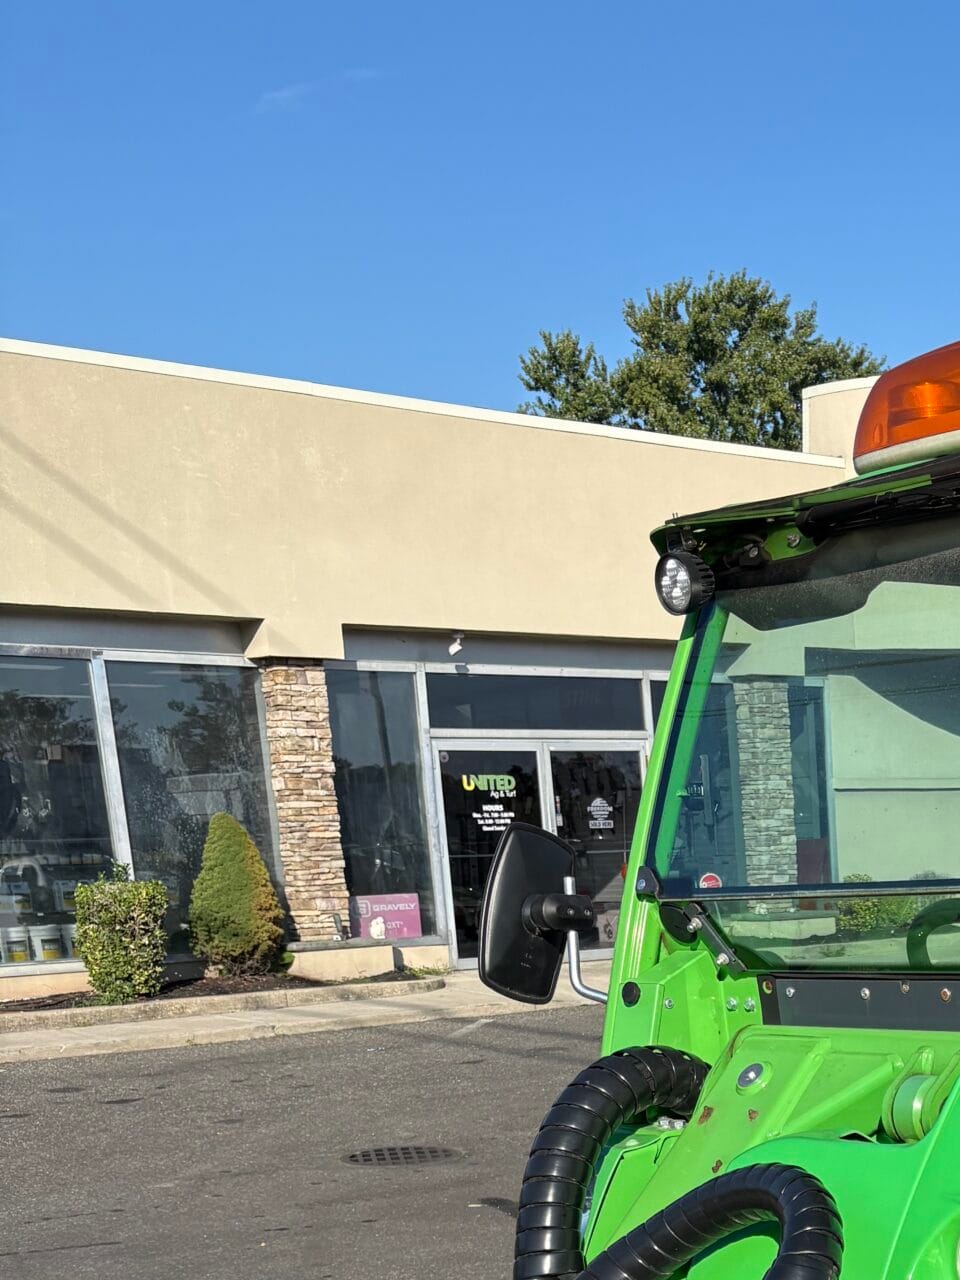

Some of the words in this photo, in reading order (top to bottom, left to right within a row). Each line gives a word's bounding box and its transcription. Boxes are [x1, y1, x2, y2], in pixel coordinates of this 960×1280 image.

[461, 774, 516, 791] UNITED
[490, 790, 499, 799] Ag
[372, 903, 416, 911] GRAVELY
